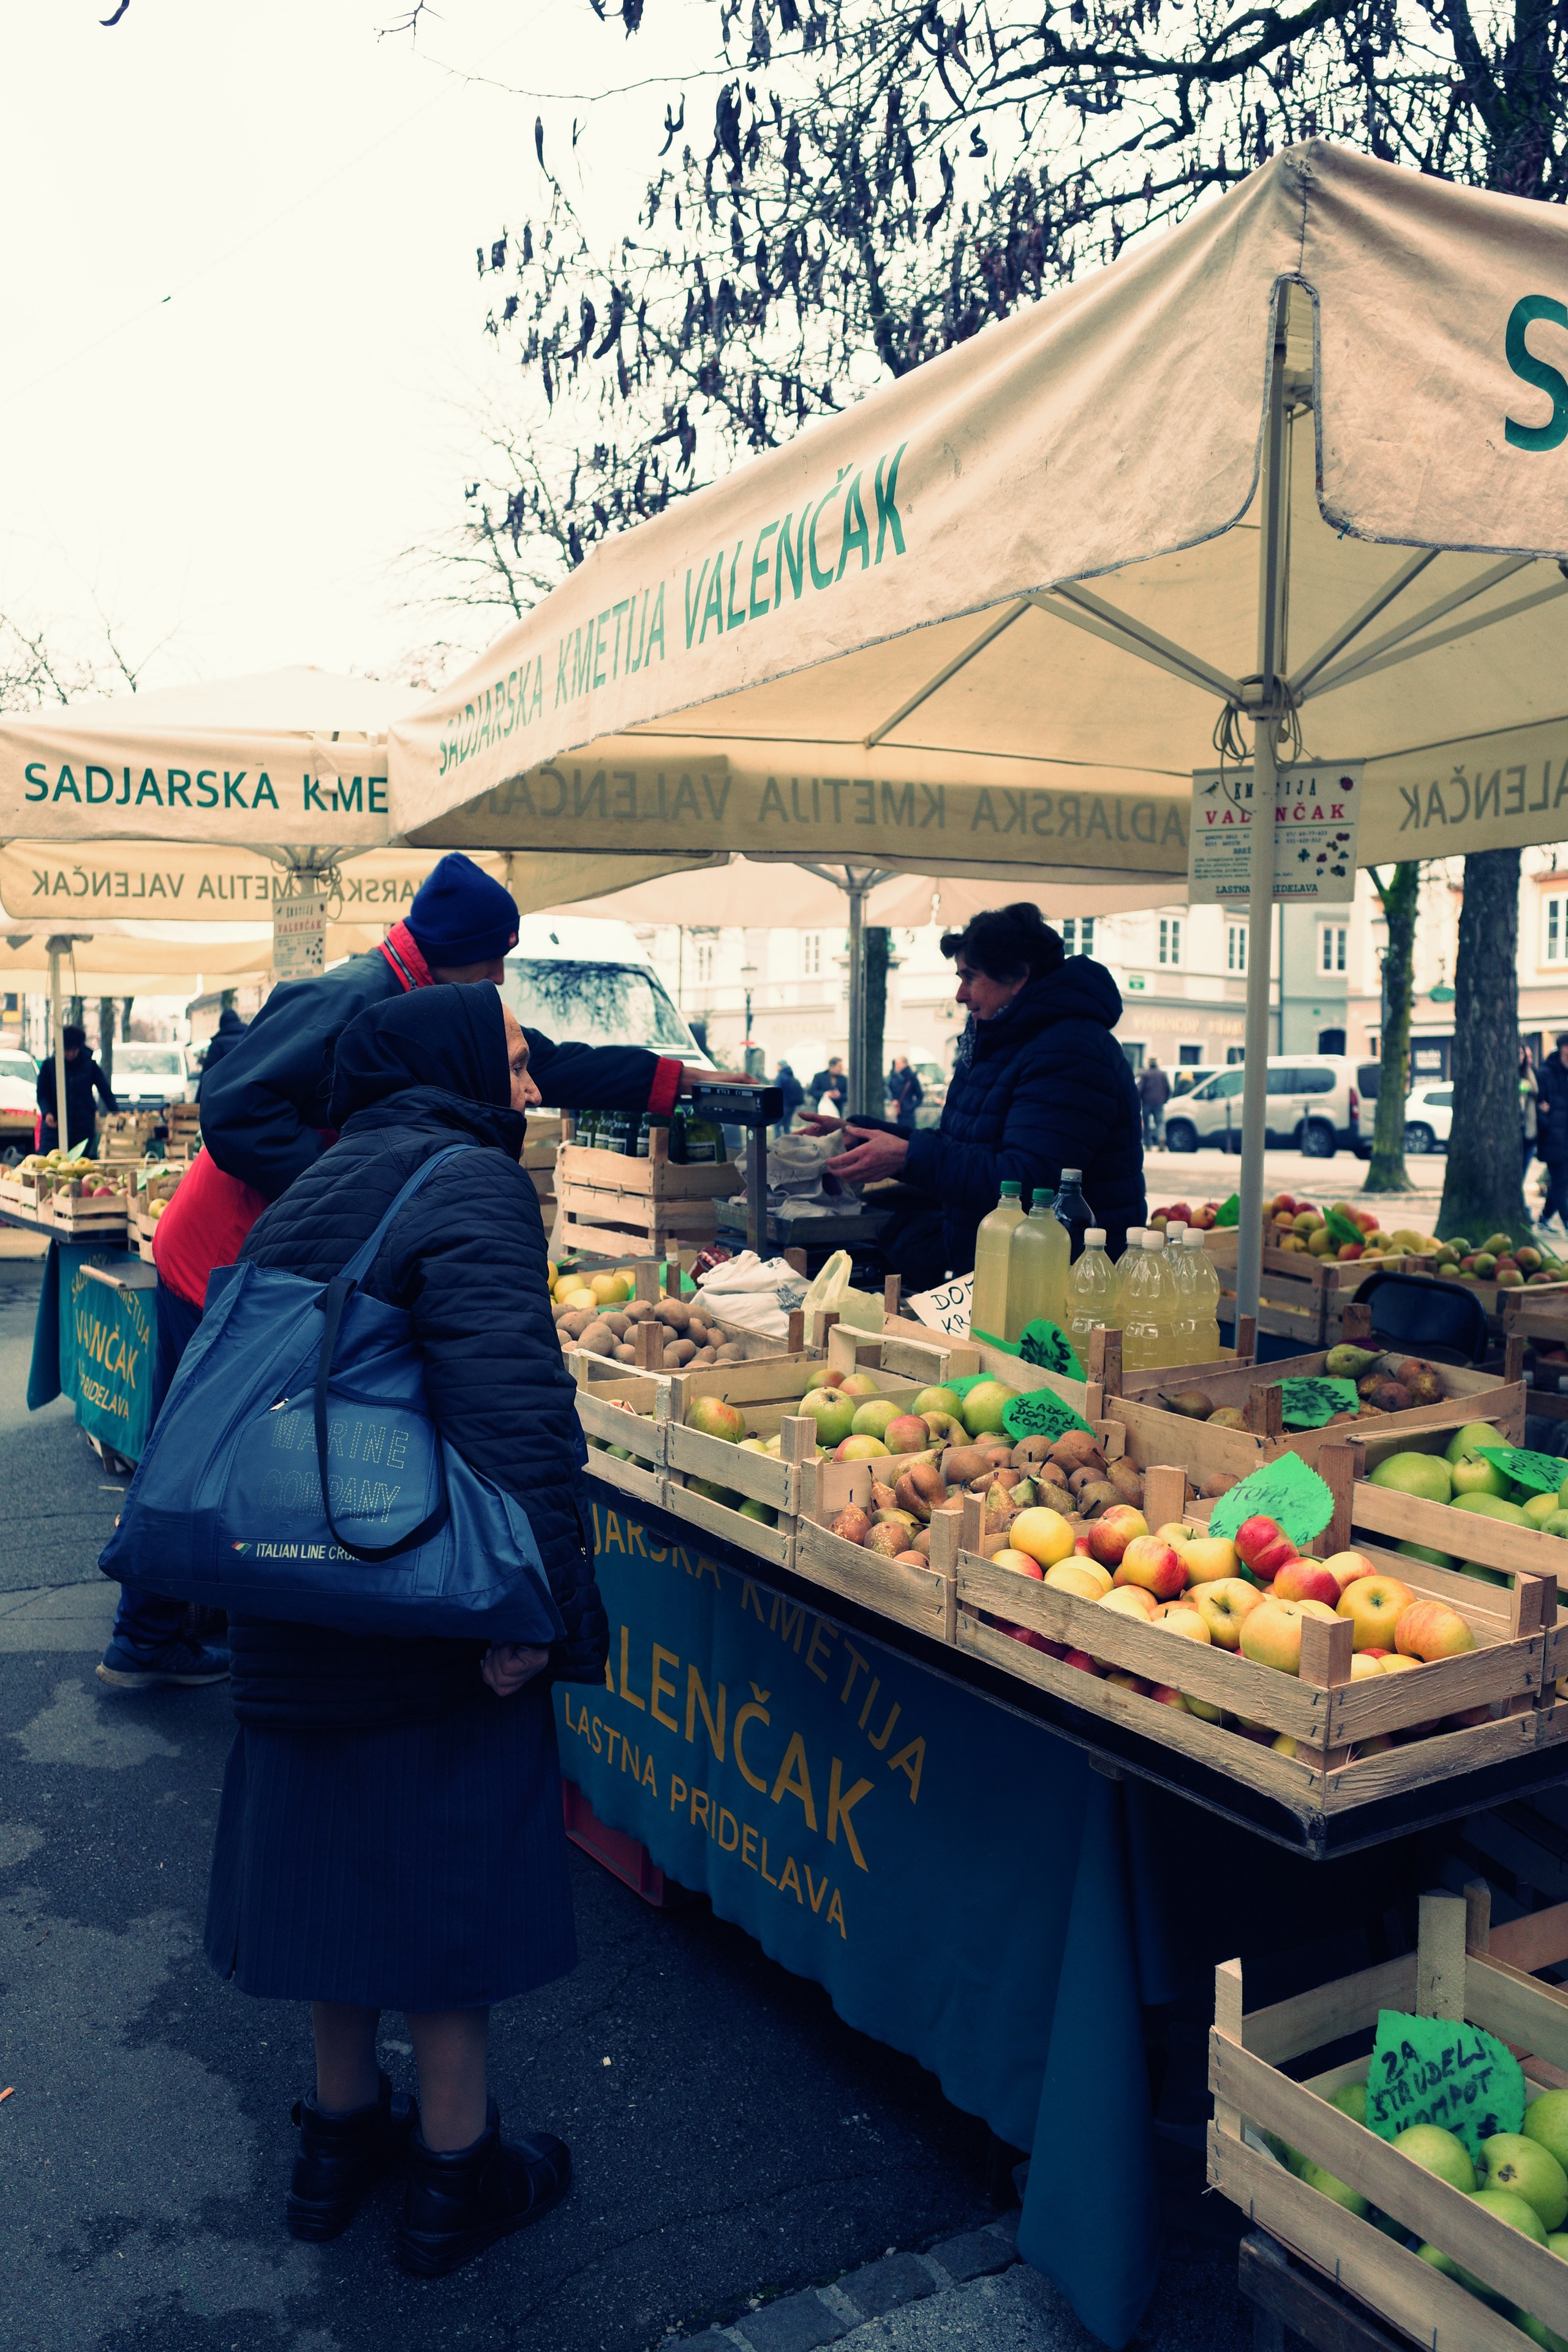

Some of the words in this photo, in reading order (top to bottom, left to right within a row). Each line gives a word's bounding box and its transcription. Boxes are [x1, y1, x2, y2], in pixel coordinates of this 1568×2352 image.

[1505, 294, 1568, 452] S
[439, 654, 543, 776] SADJARSKA
[554, 580, 666, 709] KMETIJA
[685, 440, 909, 650] VALENČAK
[24, 762, 280, 810] SADJARSKA
[303, 774, 388, 813] KME
[1206, 802, 1345, 825] VALNČAK
[1234, 777, 1316, 800] KMIJA
[1273, 883, 1319, 893] IDELAVA
[115, 1289, 150, 1354] METIJA
[941, 1309, 973, 1335] KR
[271, 1408, 409, 1469] MARINE
[260, 1469, 401, 1523] COMPANY
[256, 1543, 298, 1558] ITALIAN
[300, 1544, 326, 1560] LINE
[328, 1545, 360, 1561] CRU
[565, 1692, 658, 1798] LASTNA
[670, 1774, 847, 1940] PRIDELAVA
